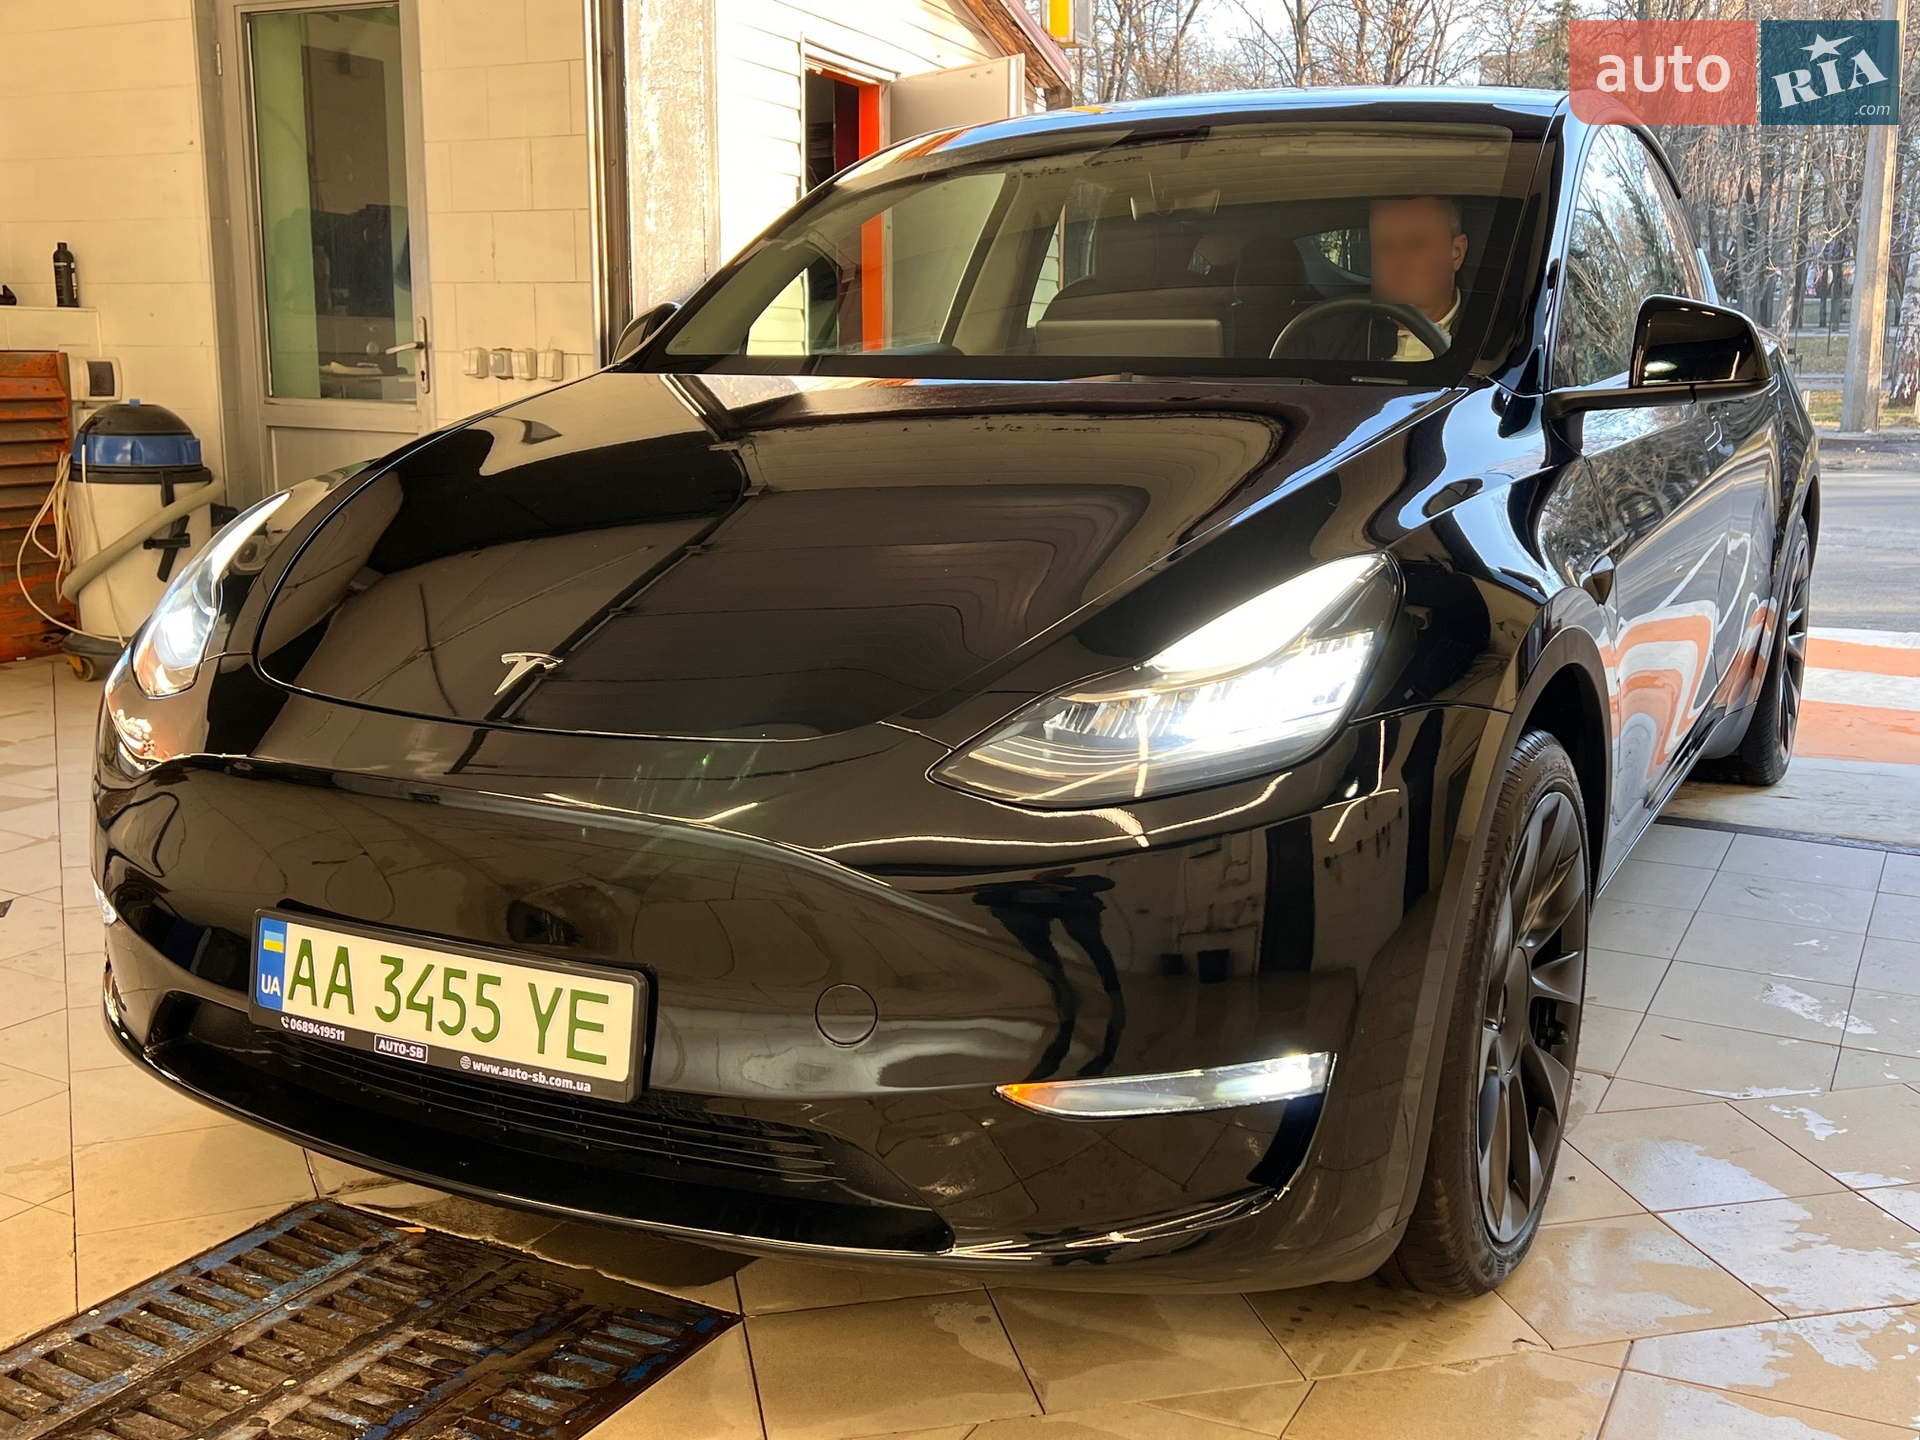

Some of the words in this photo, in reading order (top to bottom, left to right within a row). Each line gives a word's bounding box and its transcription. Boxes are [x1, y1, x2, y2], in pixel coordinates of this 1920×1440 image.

[261, 973, 282, 997] UA
[287, 938, 355, 1015] AA
[374, 954, 502, 1043] 3455
[527, 982, 610, 1065] YE
[290, 1018, 345, 1042] 0689419511
[378, 1039, 424, 1059] AUTO-SB
[472, 1060, 592, 1093] www.auto-sb.com.ua
